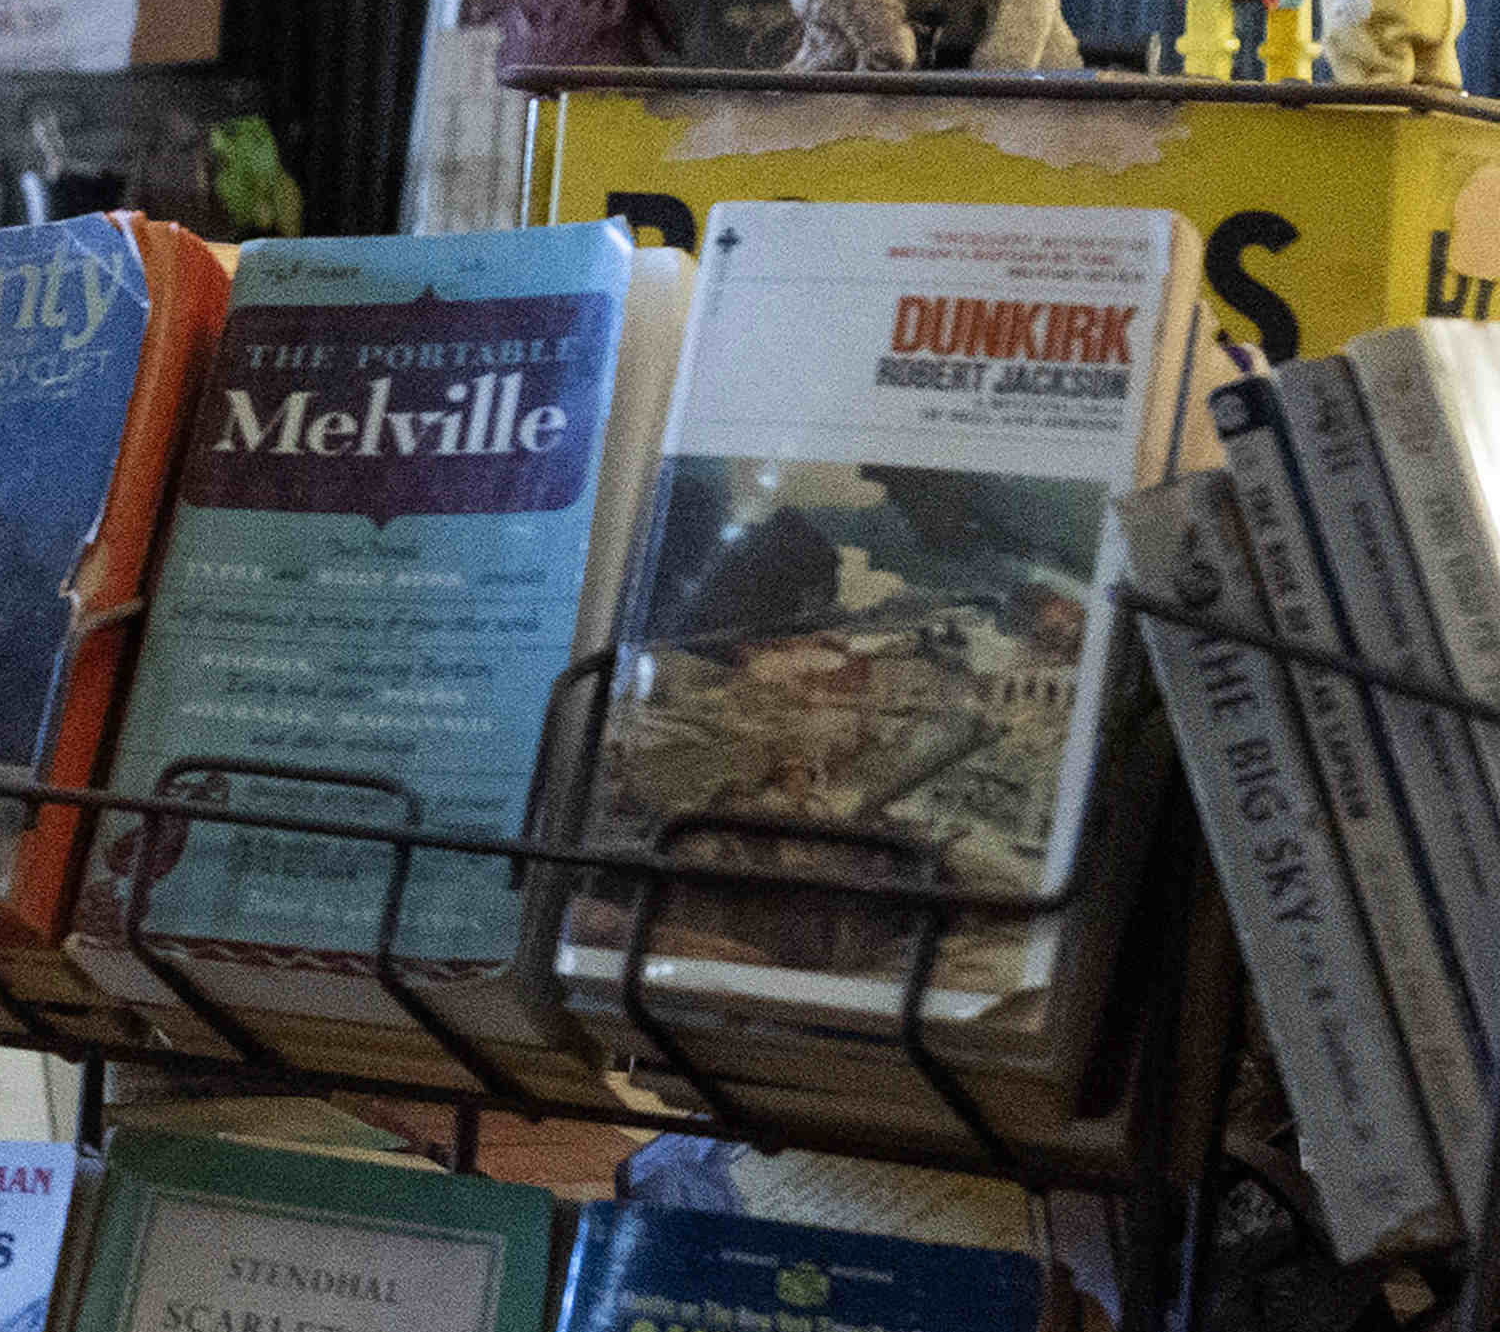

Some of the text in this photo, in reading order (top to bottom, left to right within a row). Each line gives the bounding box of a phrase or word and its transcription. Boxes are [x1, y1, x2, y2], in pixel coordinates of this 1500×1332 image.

[891, 294, 1139, 365] DUNKIRK
[875, 356, 1131, 399] ROBERT JACKSON
[215, 372, 569, 457] Melville
[225, 1253, 402, 1306] STENDHAL
